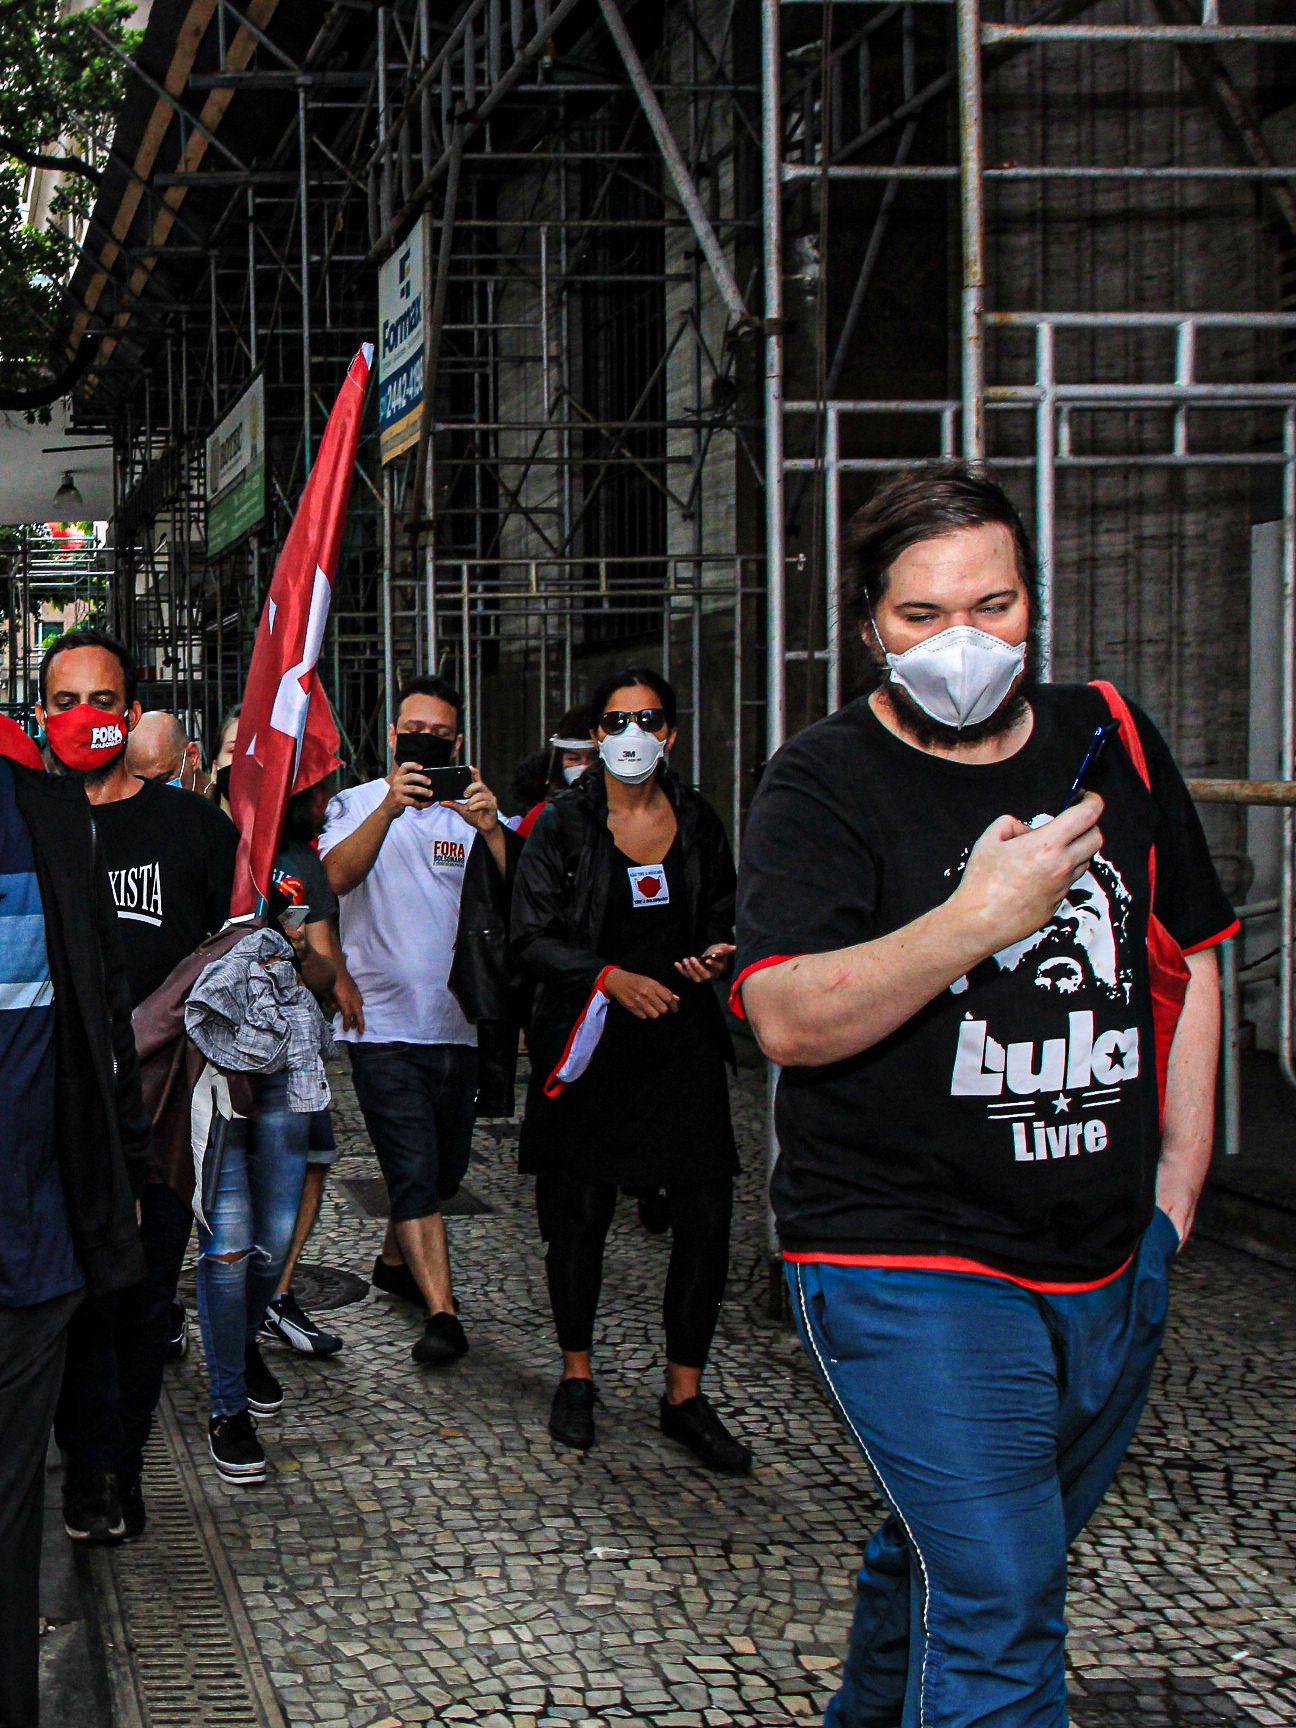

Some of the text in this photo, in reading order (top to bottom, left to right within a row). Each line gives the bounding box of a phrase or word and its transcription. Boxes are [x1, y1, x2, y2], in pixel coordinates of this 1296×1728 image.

[92, 724, 123, 744] FORA
[622, 750, 636, 758] 3M
[434, 840, 465, 858] FORA
[107, 861, 163, 916] XISTA
[949, 1010, 1140, 1097] Lula
[1012, 1118, 1109, 1162] Livre
